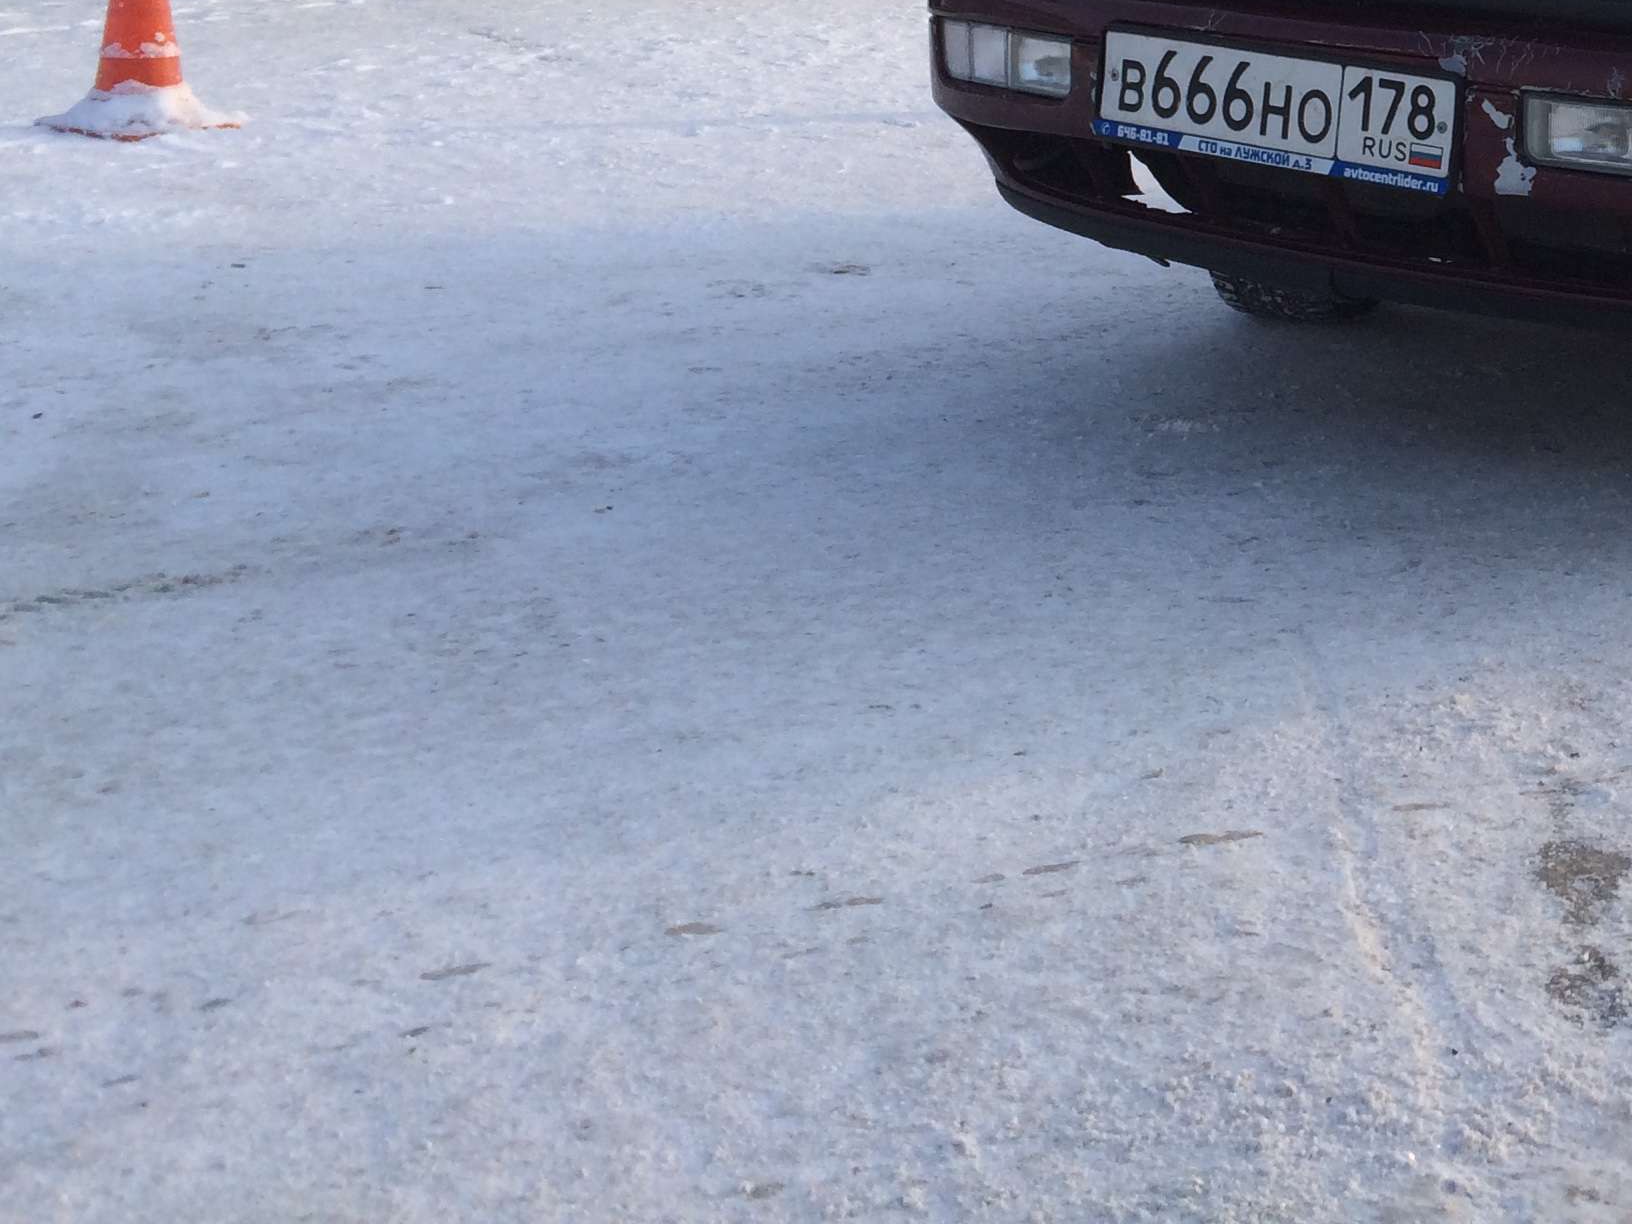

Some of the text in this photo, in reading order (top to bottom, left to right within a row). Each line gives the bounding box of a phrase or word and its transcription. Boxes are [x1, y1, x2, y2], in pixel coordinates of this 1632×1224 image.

[1118, 49, 1332, 144] В666НО
[1348, 75, 1436, 141] 178
[1198, 139, 1218, 153] СТО
[1219, 145, 1232, 156] на
[1234, 146, 1290, 166] ЛУЖСКОЙ
[1362, 136, 1407, 162] RUS
